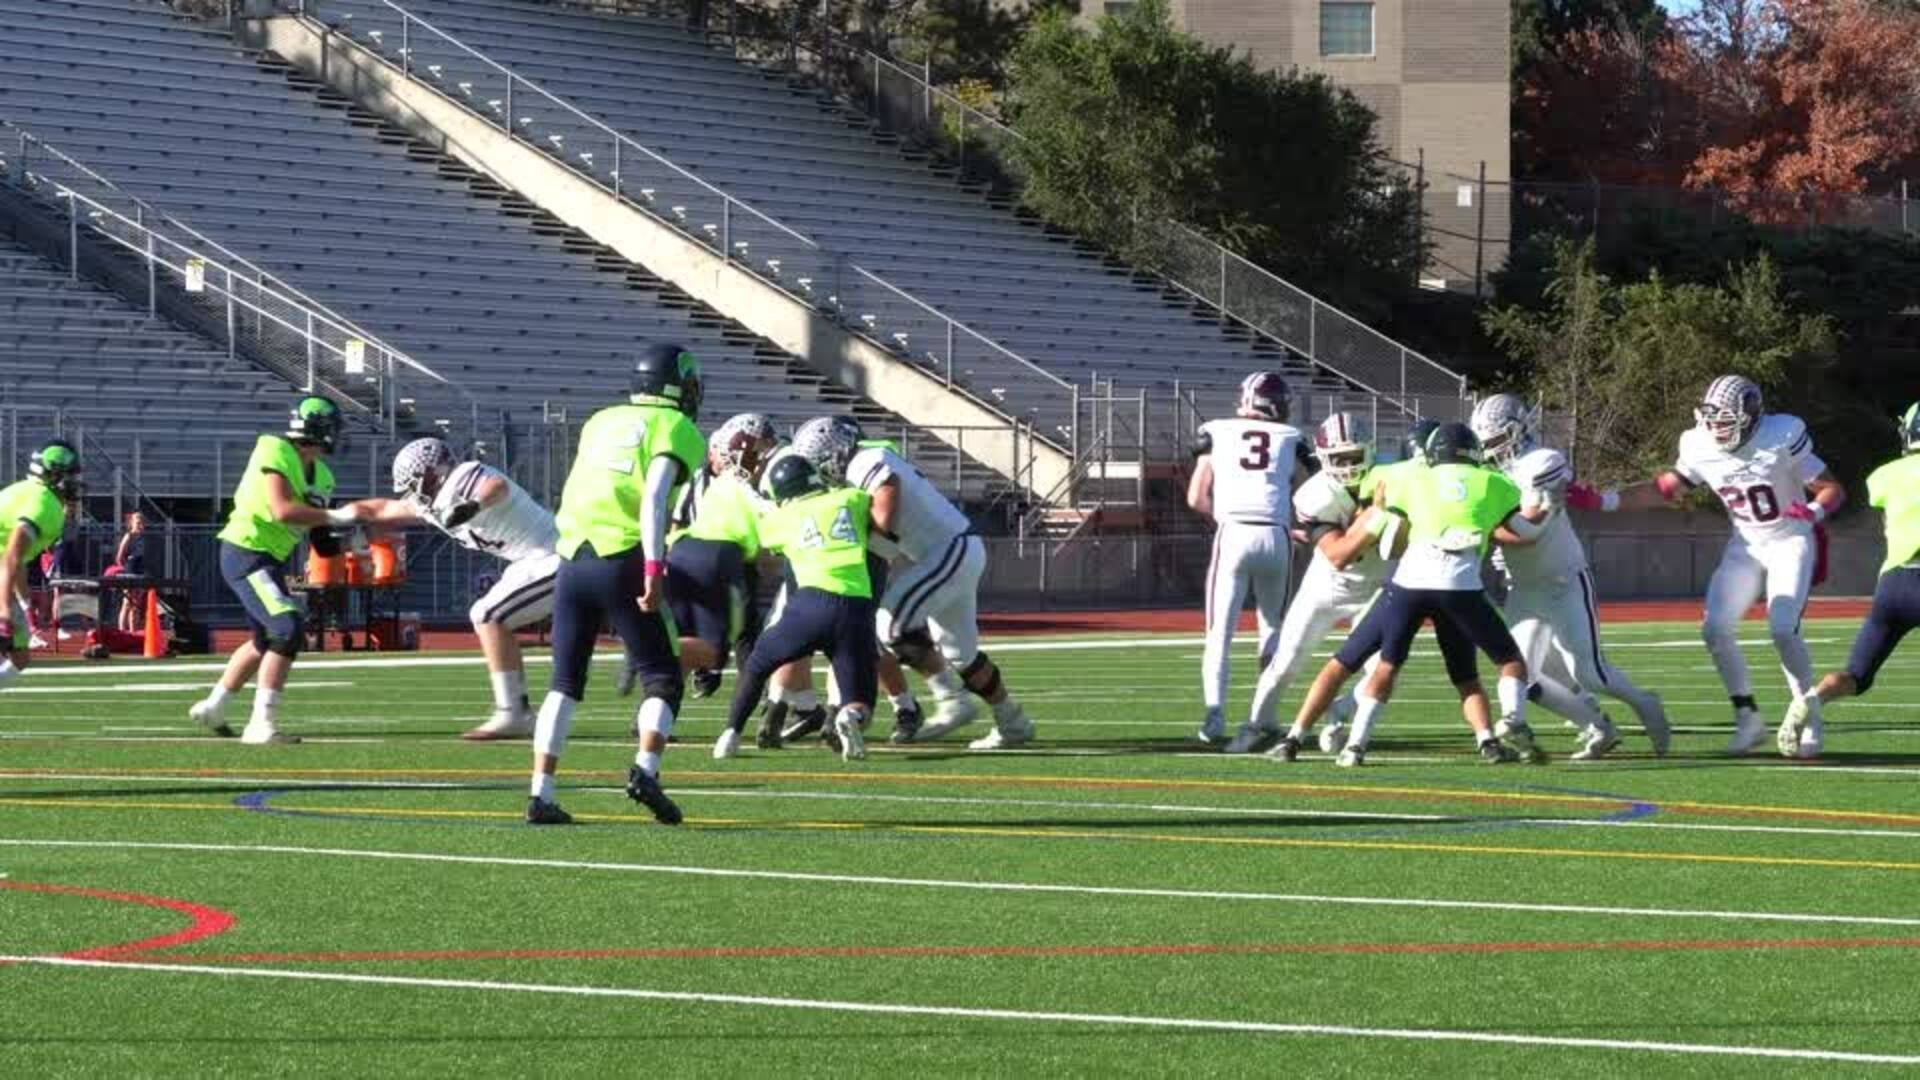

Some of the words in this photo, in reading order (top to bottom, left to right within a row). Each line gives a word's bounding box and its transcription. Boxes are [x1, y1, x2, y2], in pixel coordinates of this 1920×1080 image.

[1239, 430, 1270, 471] 3
[1717, 484, 1780, 522] 20
[799, 505, 858, 548] 44
